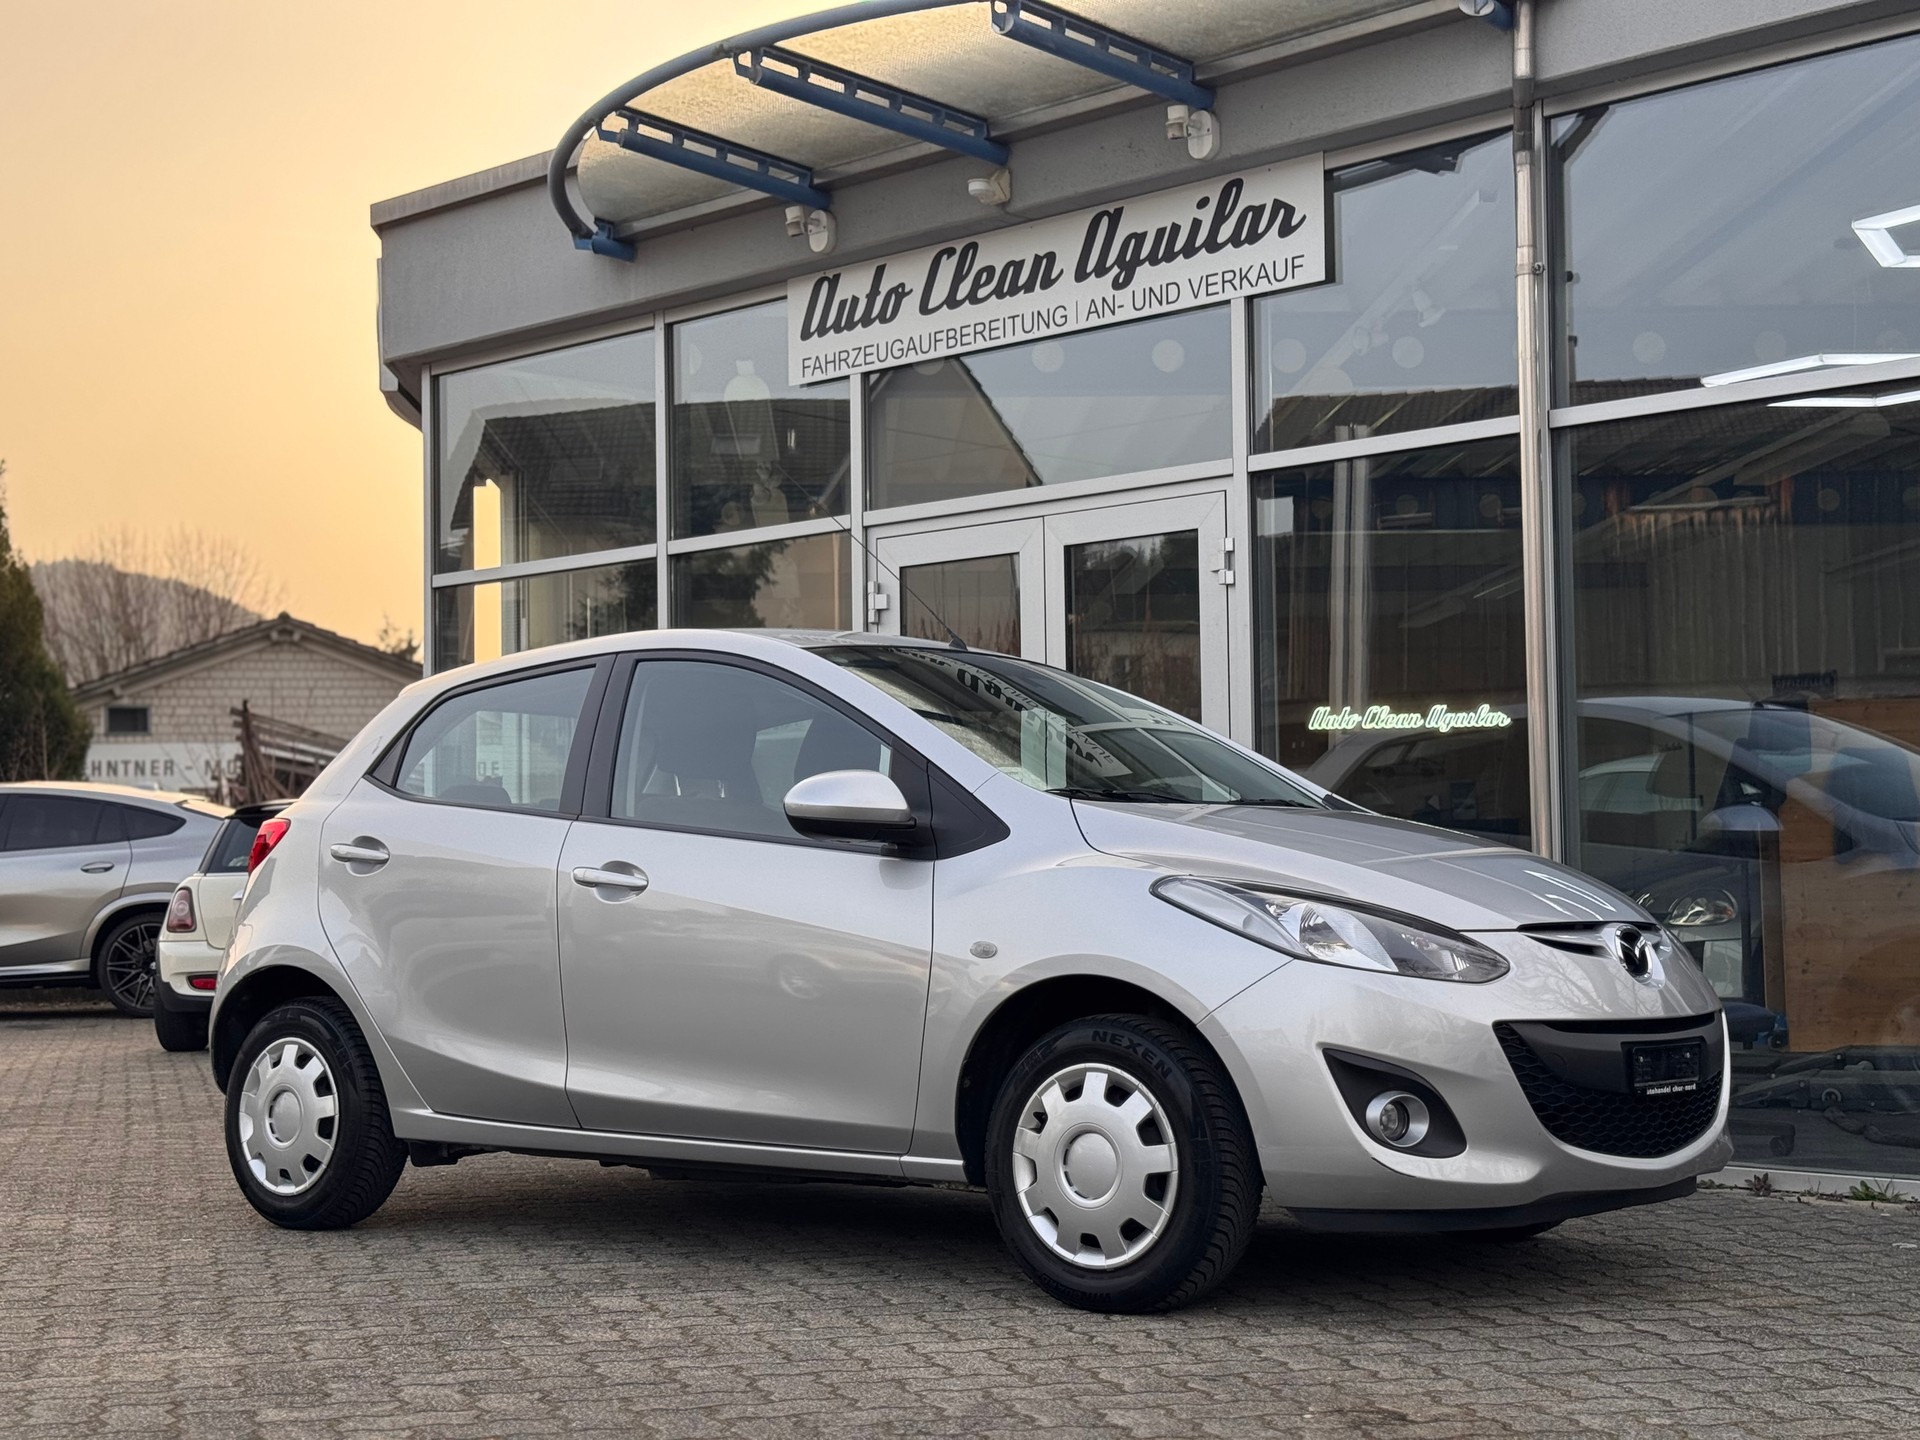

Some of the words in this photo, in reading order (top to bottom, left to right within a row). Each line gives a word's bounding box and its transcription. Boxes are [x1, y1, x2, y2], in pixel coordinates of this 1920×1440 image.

[799, 263, 913, 342] Auto
[919, 241, 1064, 316] Clean
[1074, 177, 1307, 291] Aguilar
[801, 305, 1068, 378] FAHRZEUGAUFBEREITUNG
[1131, 281, 1181, 312] UND
[1188, 254, 1305, 299] VERKAUF
[1308, 706, 1362, 730] Auto
[1362, 705, 1423, 730] Clean
[1425, 703, 1512, 733] Aguilar
[1091, 1030, 1173, 1078] NEXEN
